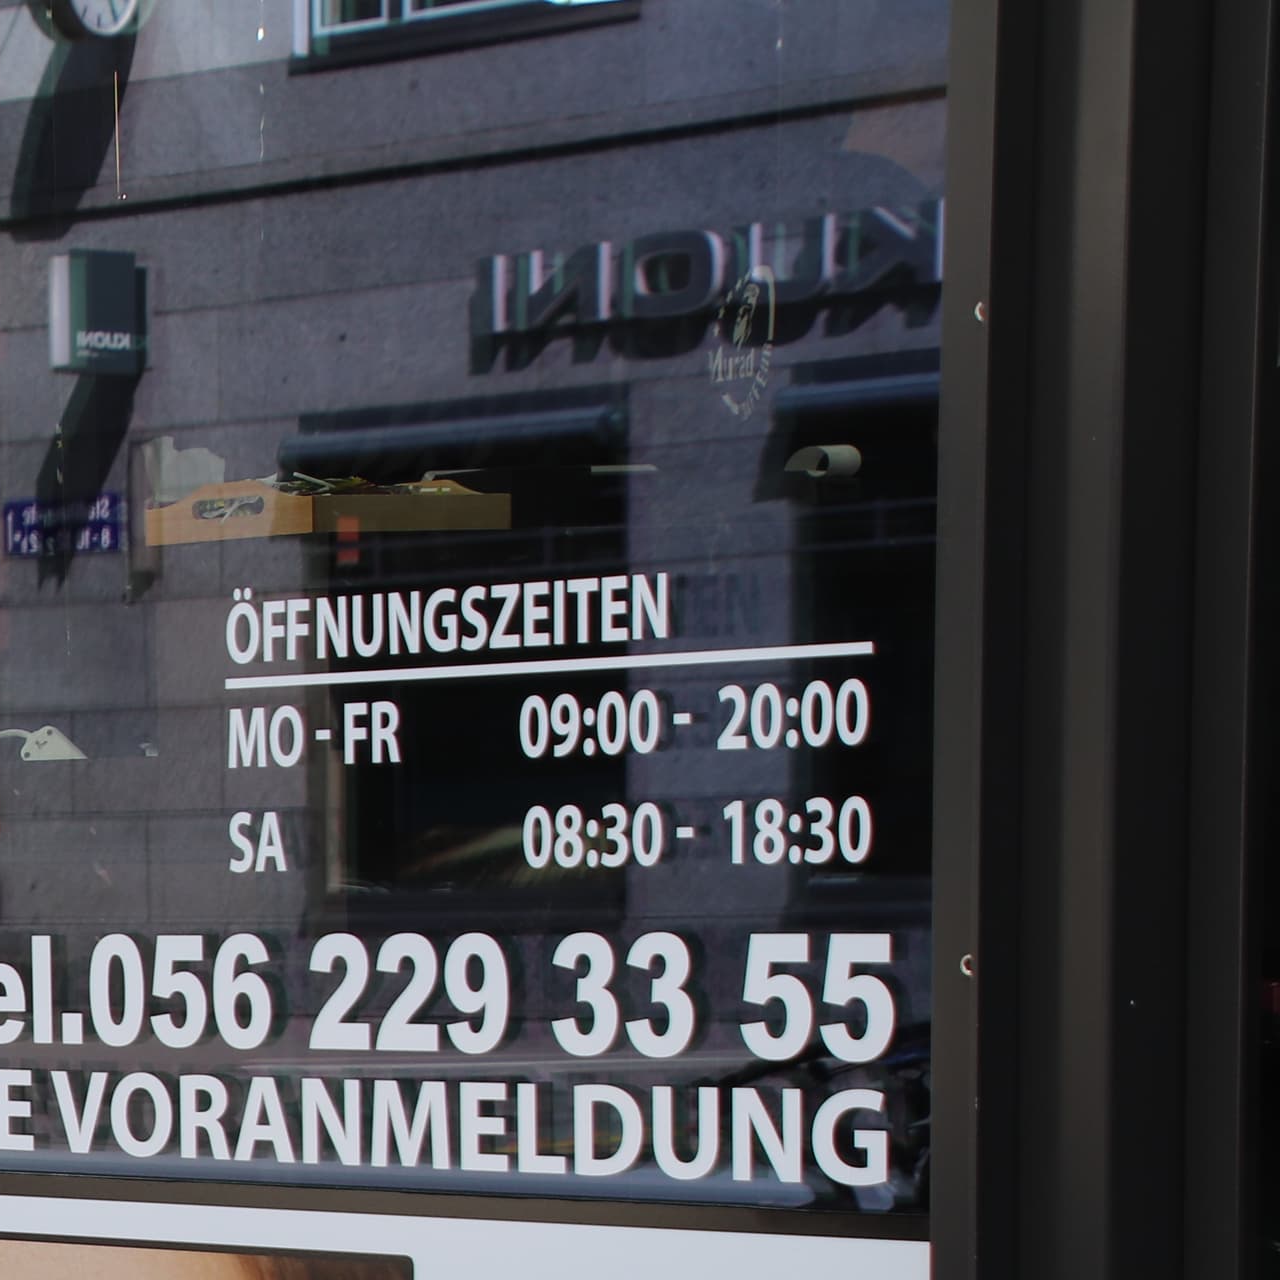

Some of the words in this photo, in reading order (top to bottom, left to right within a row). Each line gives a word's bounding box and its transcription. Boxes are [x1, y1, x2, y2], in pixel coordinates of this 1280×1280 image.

[225, 573, 669, 664] ÖFFNUNGSZEITEN
[227, 705, 304, 769] MO
[343, 701, 401, 764] FR
[519, 689, 660, 758] 09:00
[716, 678, 870, 750] 20:00
[228, 812, 288, 873] SA
[522, 801, 664, 869] 08:30
[723, 796, 872, 865] 18:30
[309, 932, 509, 1055] 229
[550, 932, 694, 1060] 33
[739, 931, 895, 1062] 55
[52, 1069, 892, 1188] VORANMELDUNG
